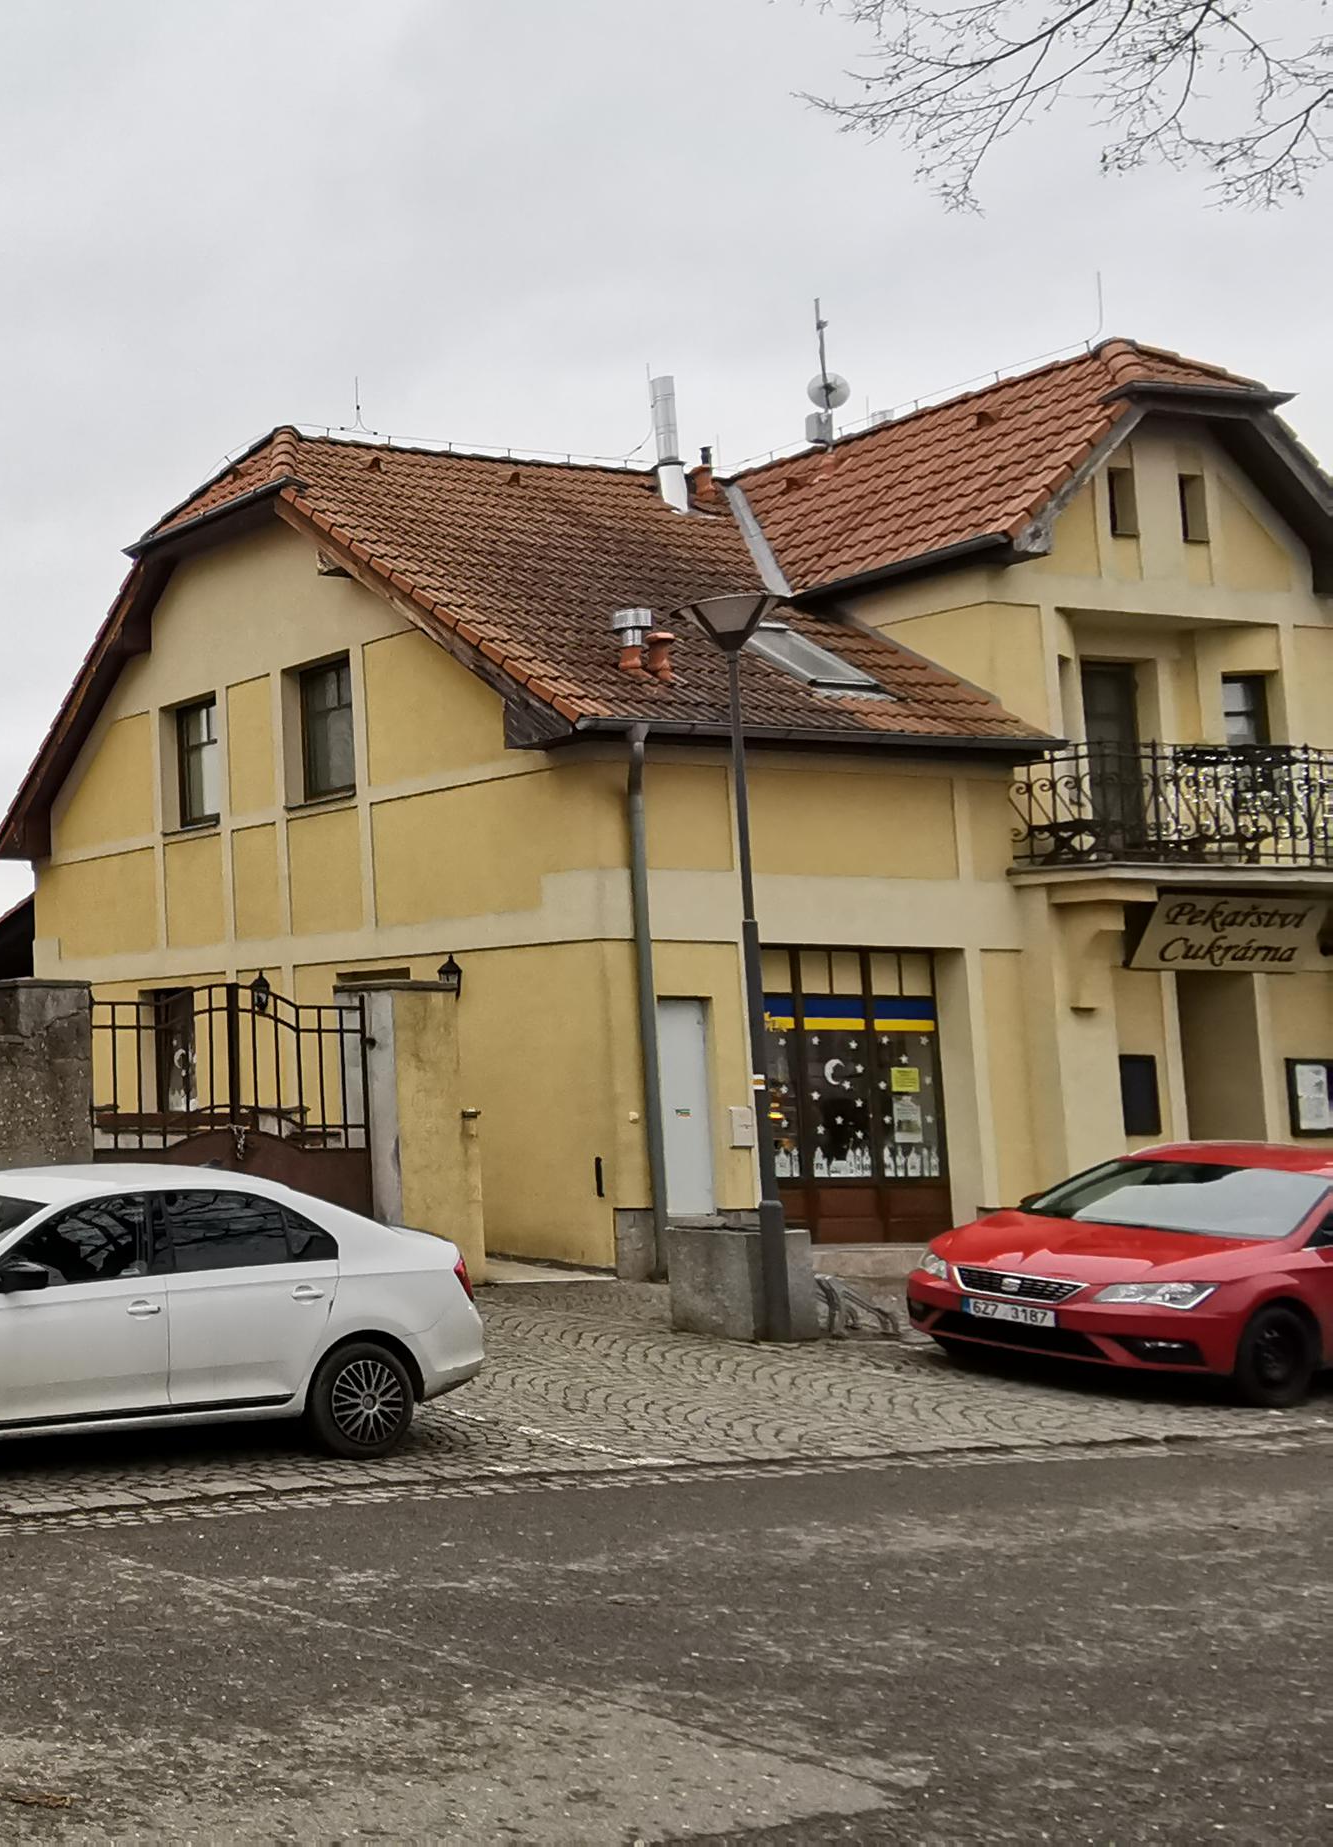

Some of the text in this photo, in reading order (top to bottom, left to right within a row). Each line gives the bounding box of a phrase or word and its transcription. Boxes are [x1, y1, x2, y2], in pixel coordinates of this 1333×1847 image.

[1165, 900, 1315, 933] Pekařství
[1158, 935, 1299, 967] Cukrárna
[1010, 1307, 1048, 1324] 3187
